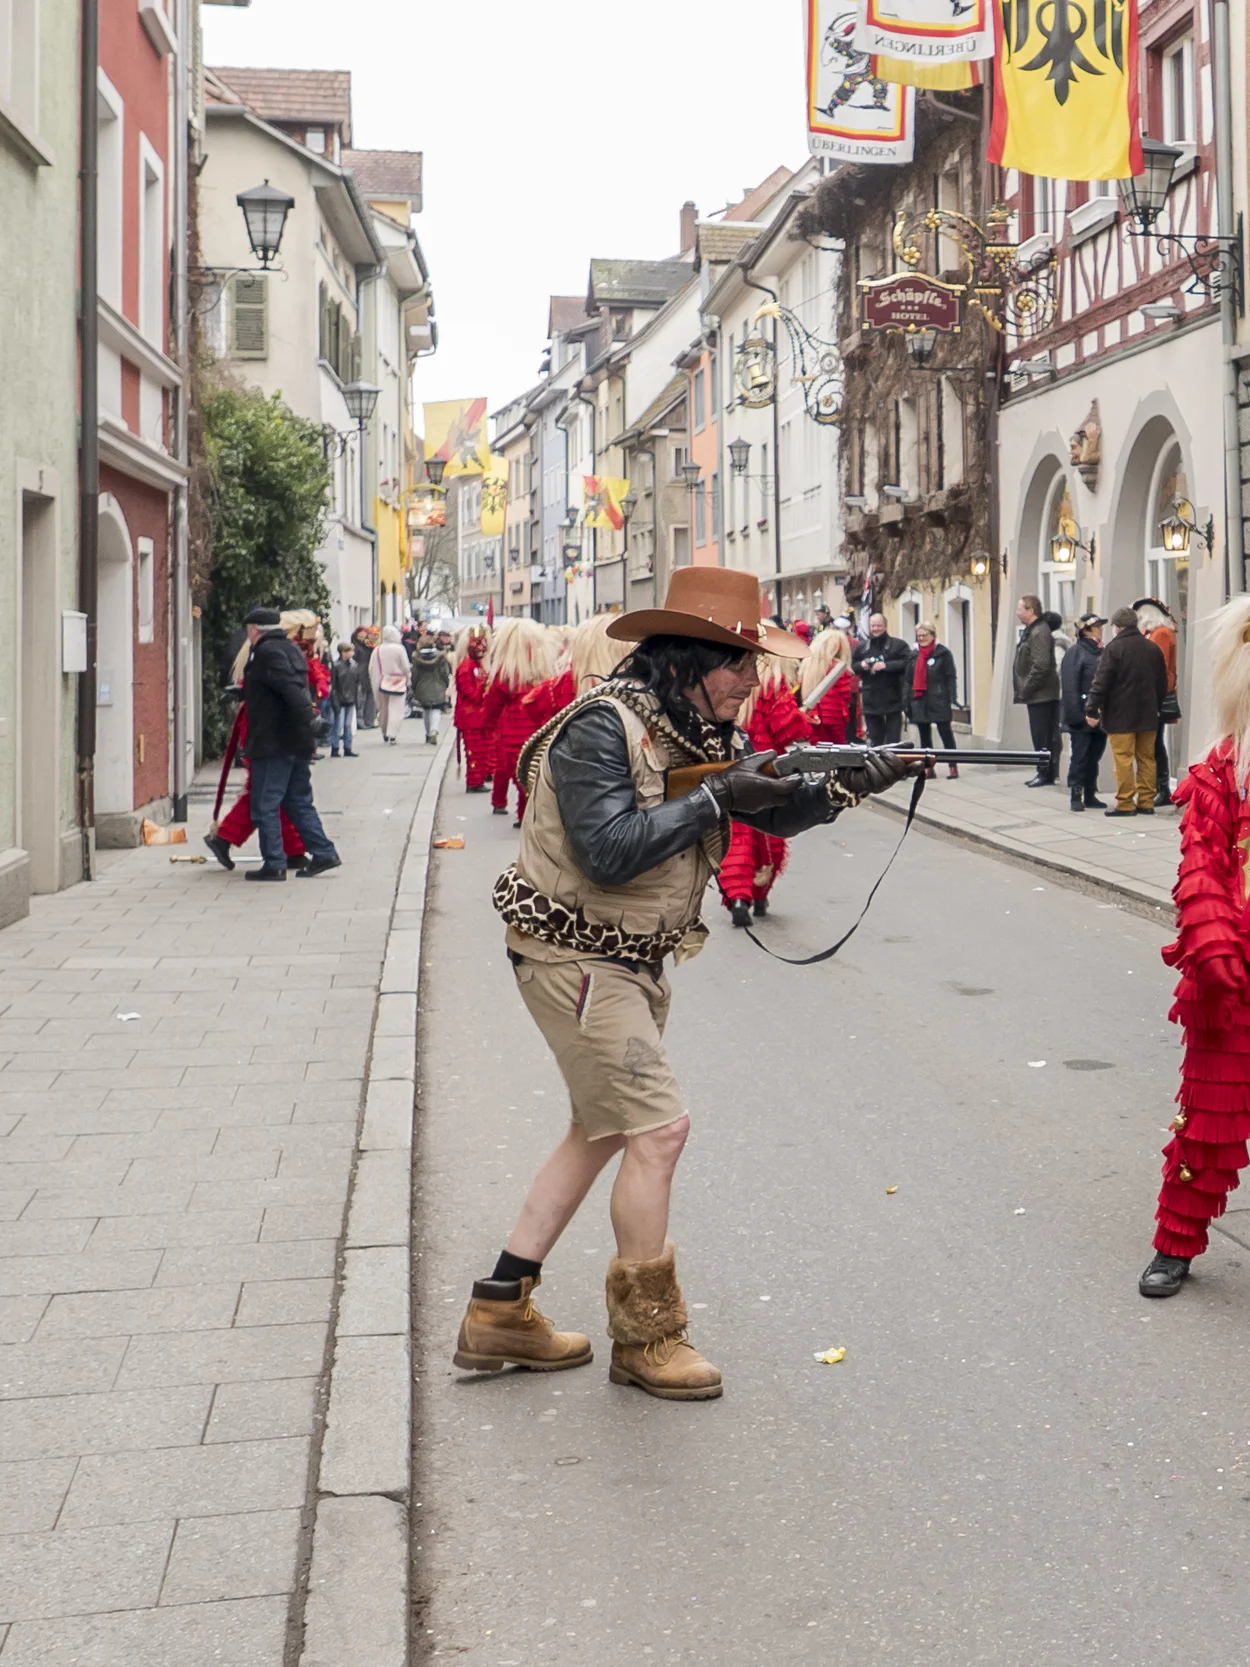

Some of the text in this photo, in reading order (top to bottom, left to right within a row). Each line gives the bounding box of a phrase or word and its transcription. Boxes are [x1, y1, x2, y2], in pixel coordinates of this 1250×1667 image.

[812, 136, 897, 156] ÜBERLINGEN
[874, 287, 948, 310] Schäpfle
[890, 312, 930, 320] HOTEL
